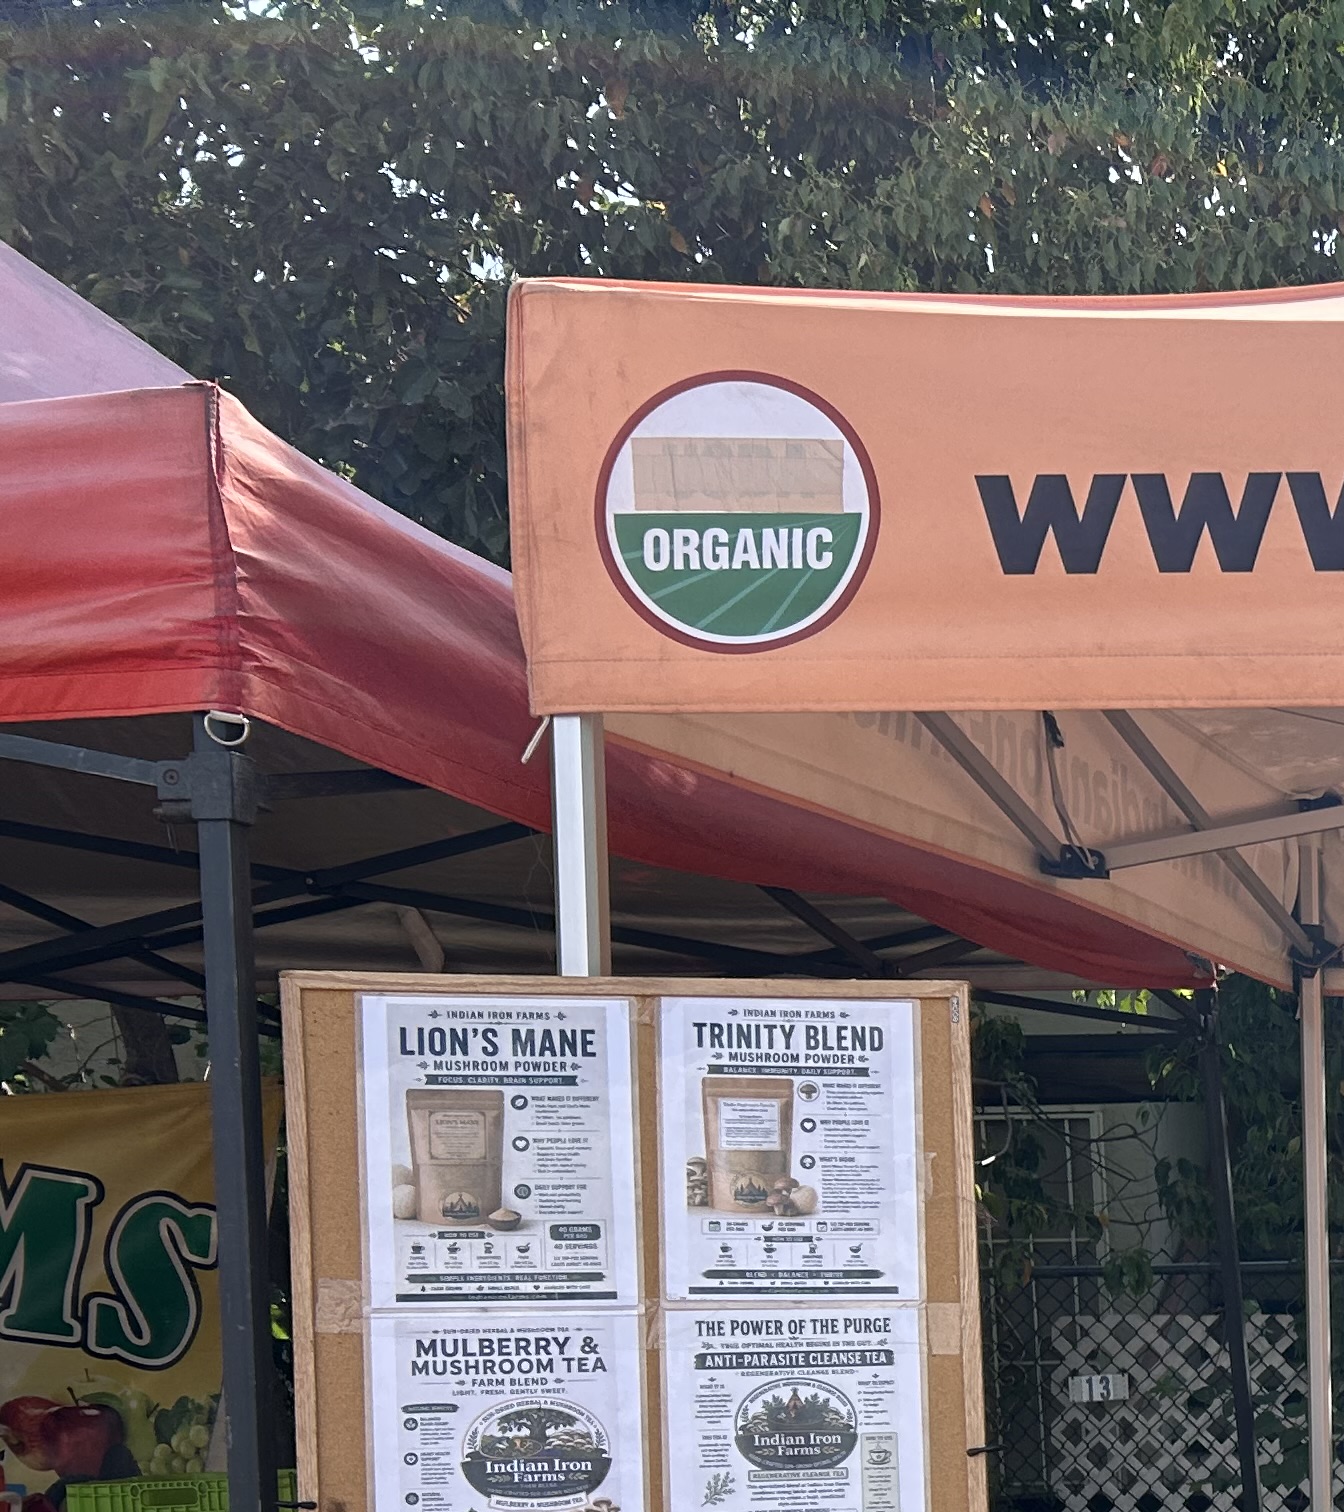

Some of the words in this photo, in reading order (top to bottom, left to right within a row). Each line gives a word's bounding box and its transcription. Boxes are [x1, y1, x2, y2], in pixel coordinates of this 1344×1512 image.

[642, 526, 833, 573] ORGANIC
[400, 1027, 499, 1056] LION'S
[512, 1028, 596, 1057] MANE
[693, 1022, 795, 1050] TRINITY
[806, 1025, 884, 1051] BLEND
[434, 1061, 509, 1071] MUSHROOM
[515, 1062, 567, 1072] POWDER
[695, 1320, 725, 1337] THE
[731, 1319, 784, 1336] POWER
[788, 1319, 806, 1335] OF
[810, 1319, 838, 1334] THE
[843, 1318, 891, 1333] PURGE
[416, 1337, 571, 1357] MULBERRY
[580, 1336, 599, 1355] &
[412, 1358, 553, 1376] MUSHROOM
[563, 1357, 607, 1373] TEA
[705, 1353, 805, 1367] ANTI-PARASITE
[809, 1352, 861, 1365] CLEANSE
[865, 1352, 886, 1364] TEA
[1086, 1376, 1111, 1401] 13
